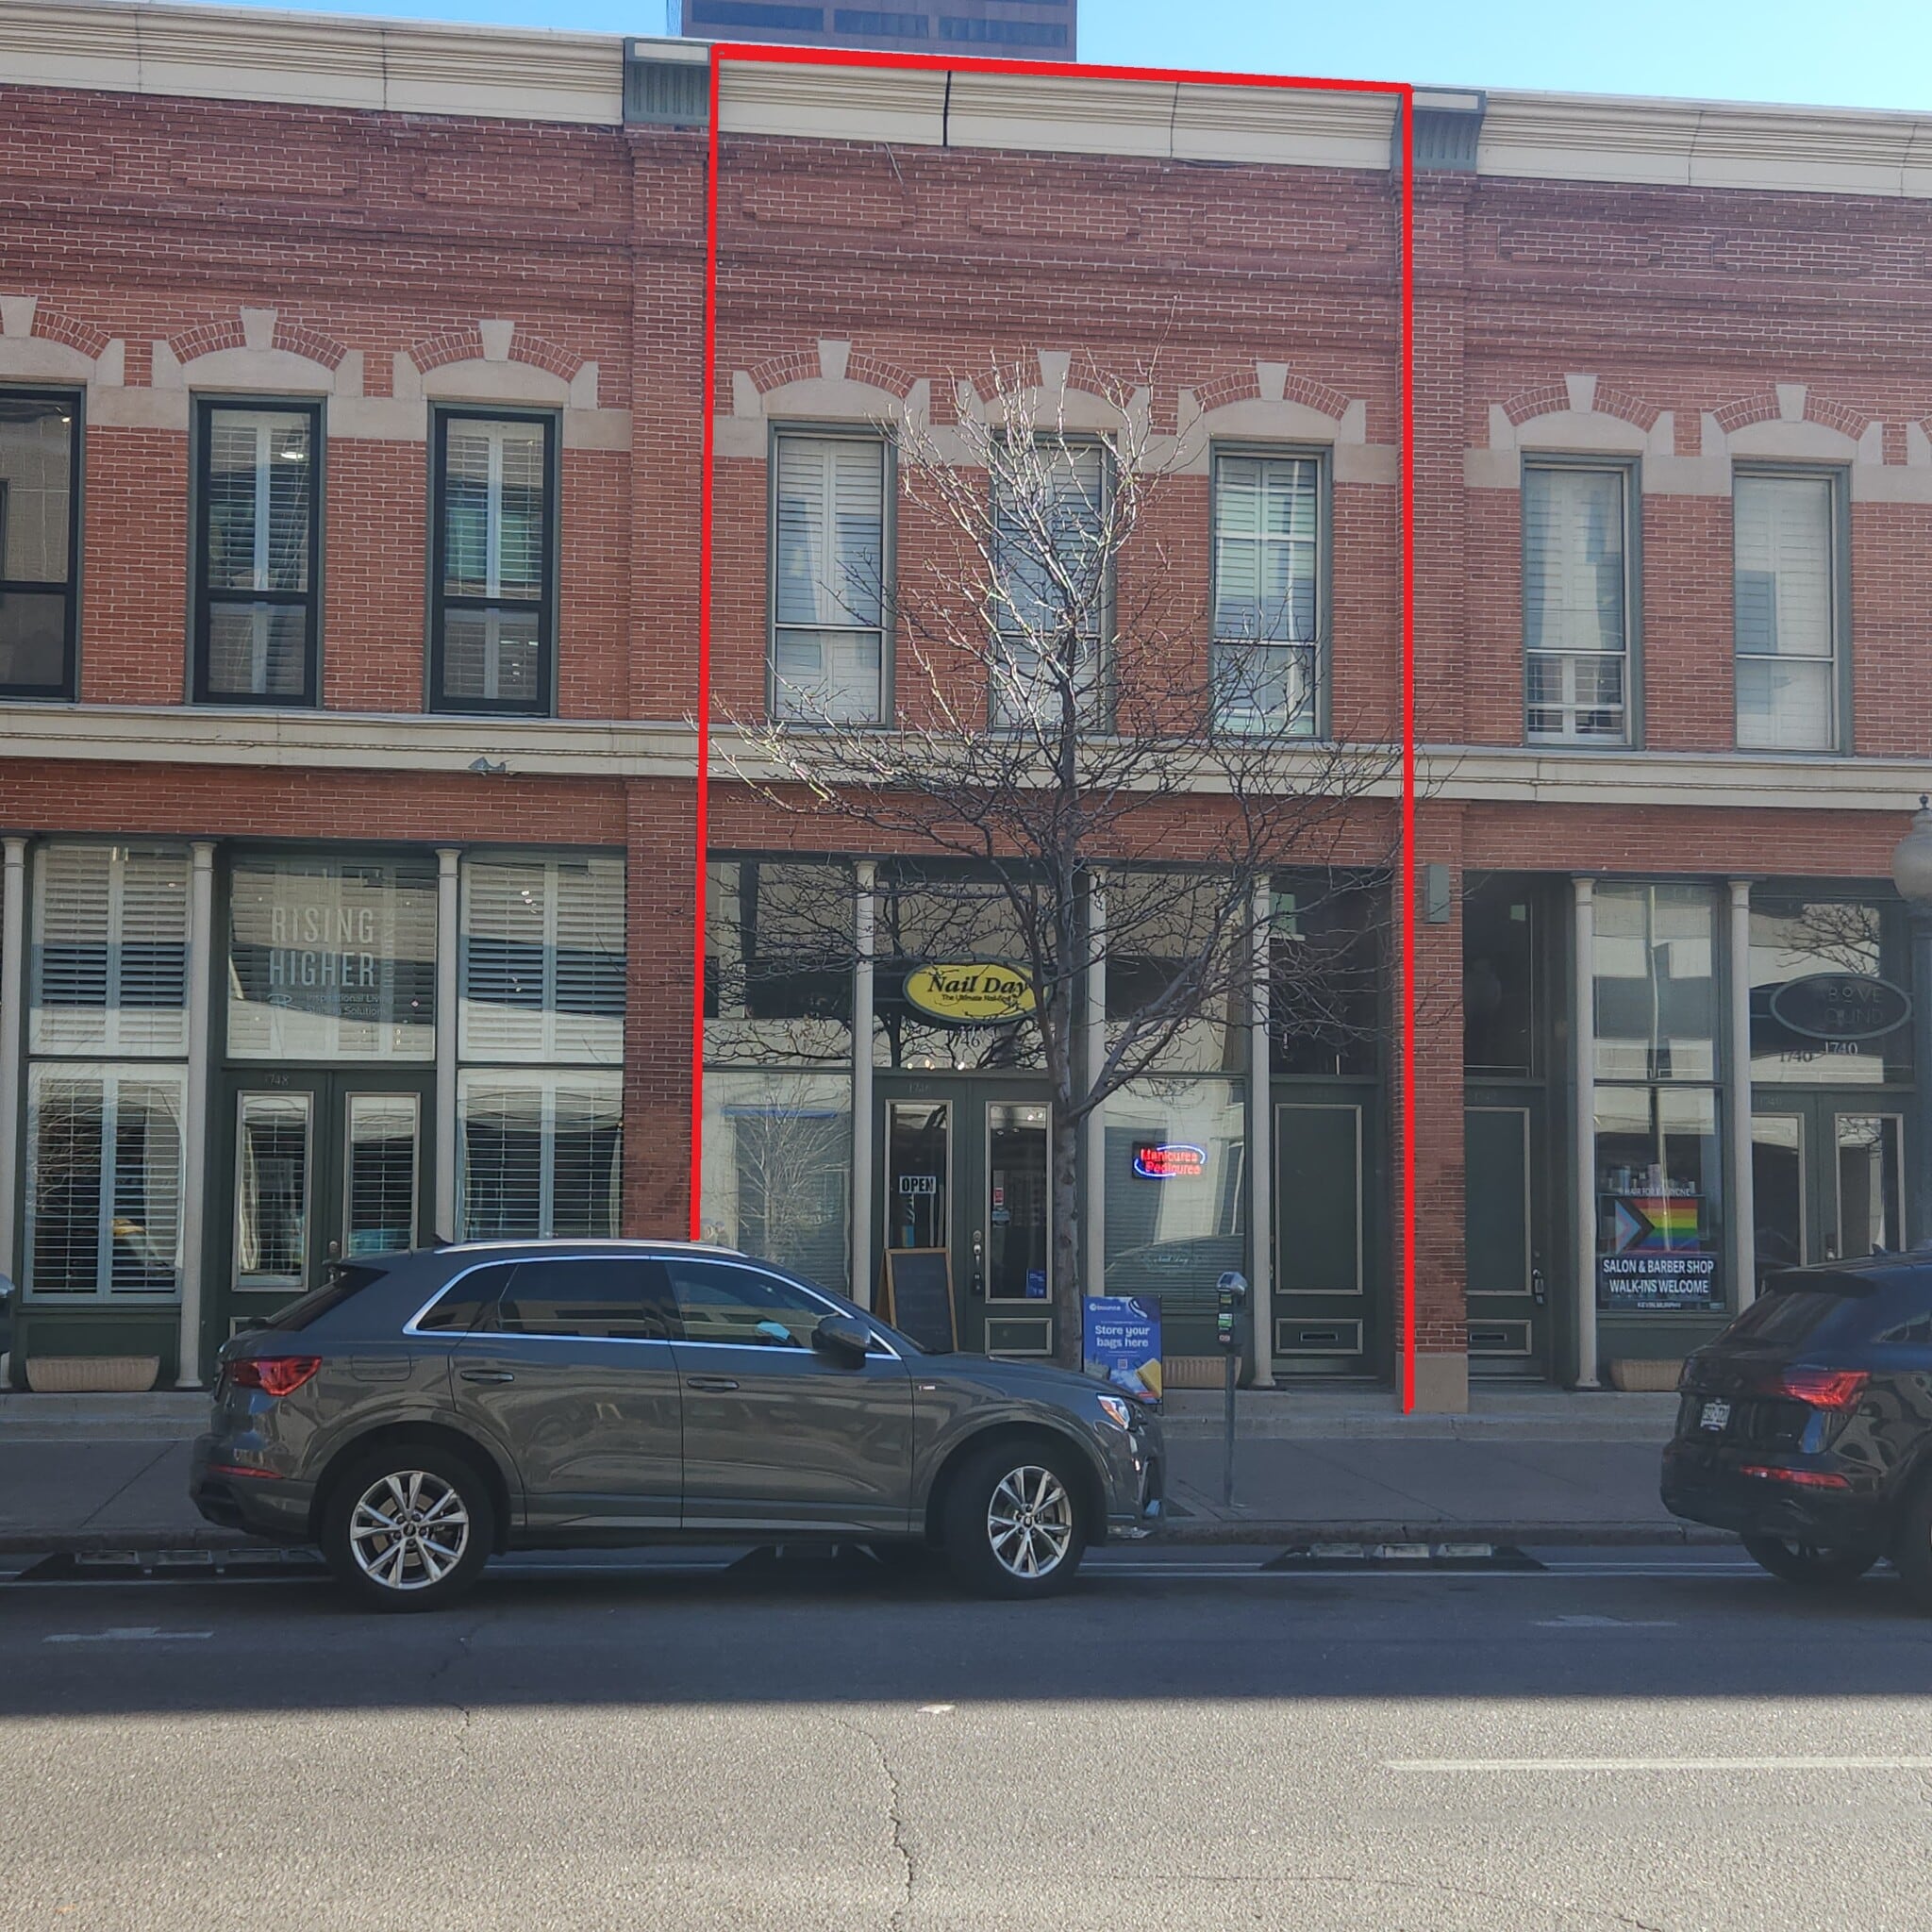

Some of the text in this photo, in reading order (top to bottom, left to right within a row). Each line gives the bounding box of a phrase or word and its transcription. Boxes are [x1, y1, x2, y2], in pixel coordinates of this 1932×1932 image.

[271, 906, 375, 944] RISING
[269, 949, 375, 988] HIGHER
[927, 974, 1028, 998] Nail Day
[1824, 1041, 1858, 1056] 1740
[902, 1176, 934, 1192] OPEN
[1603, 1259, 1714, 1274] SALON & BARBER SHOP
[1608, 1279, 1709, 1293] WALK-INS WELCOME
[1094, 1324, 1151, 1338] Store your
[1096, 1337, 1149, 1350] bags here
